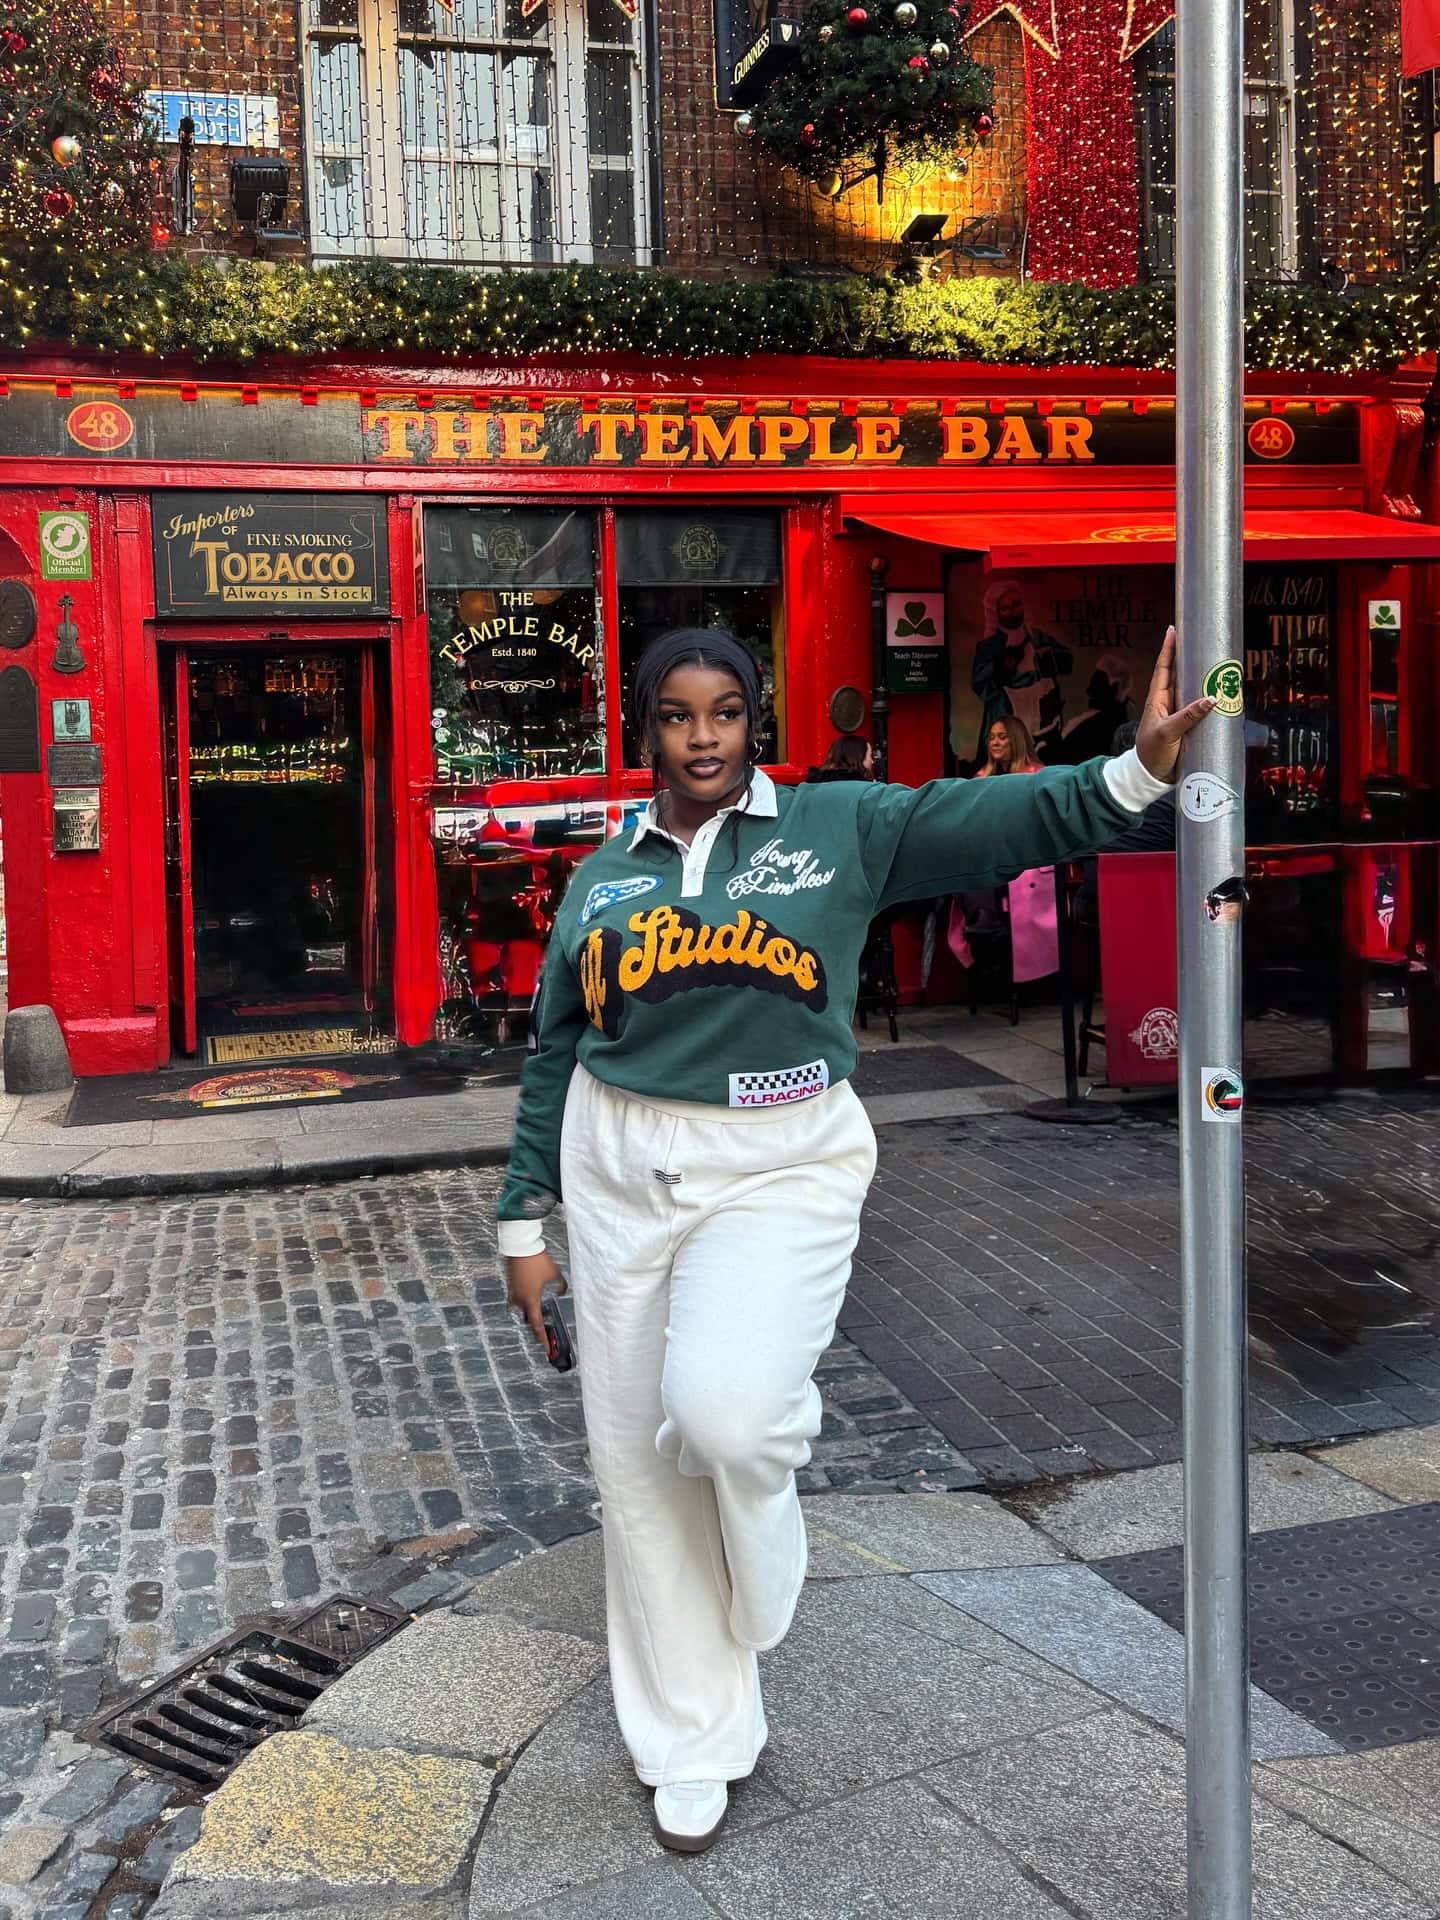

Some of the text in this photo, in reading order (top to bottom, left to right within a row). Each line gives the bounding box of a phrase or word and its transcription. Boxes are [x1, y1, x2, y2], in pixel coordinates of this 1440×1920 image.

[734, 28, 770, 85] GUINNESS
[178, 100, 239, 118] THEAS
[184, 119, 240, 138] OUTH
[79, 409, 119, 438] 48
[363, 410, 1095, 464] THE TEMPLE BAR
[1255, 425, 1284, 450] 48
[163, 503, 255, 541] Importers
[222, 525, 239, 536] OF
[247, 533, 353, 547] FINE SMOKING
[50, 566, 84, 574] Member
[52, 558, 81, 566] Official
[189, 541, 356, 596] TOBACCO
[225, 586, 369, 601] Always in Stock
[499, 592, 535, 606] THE
[438, 616, 595, 667] TEMPLE BAR
[1077, 624, 1135, 648] BAR
[491, 648, 537, 657] Estd. 1840
[618, 905, 818, 992] Studios
[737, 1081, 825, 1105] YLRACING
